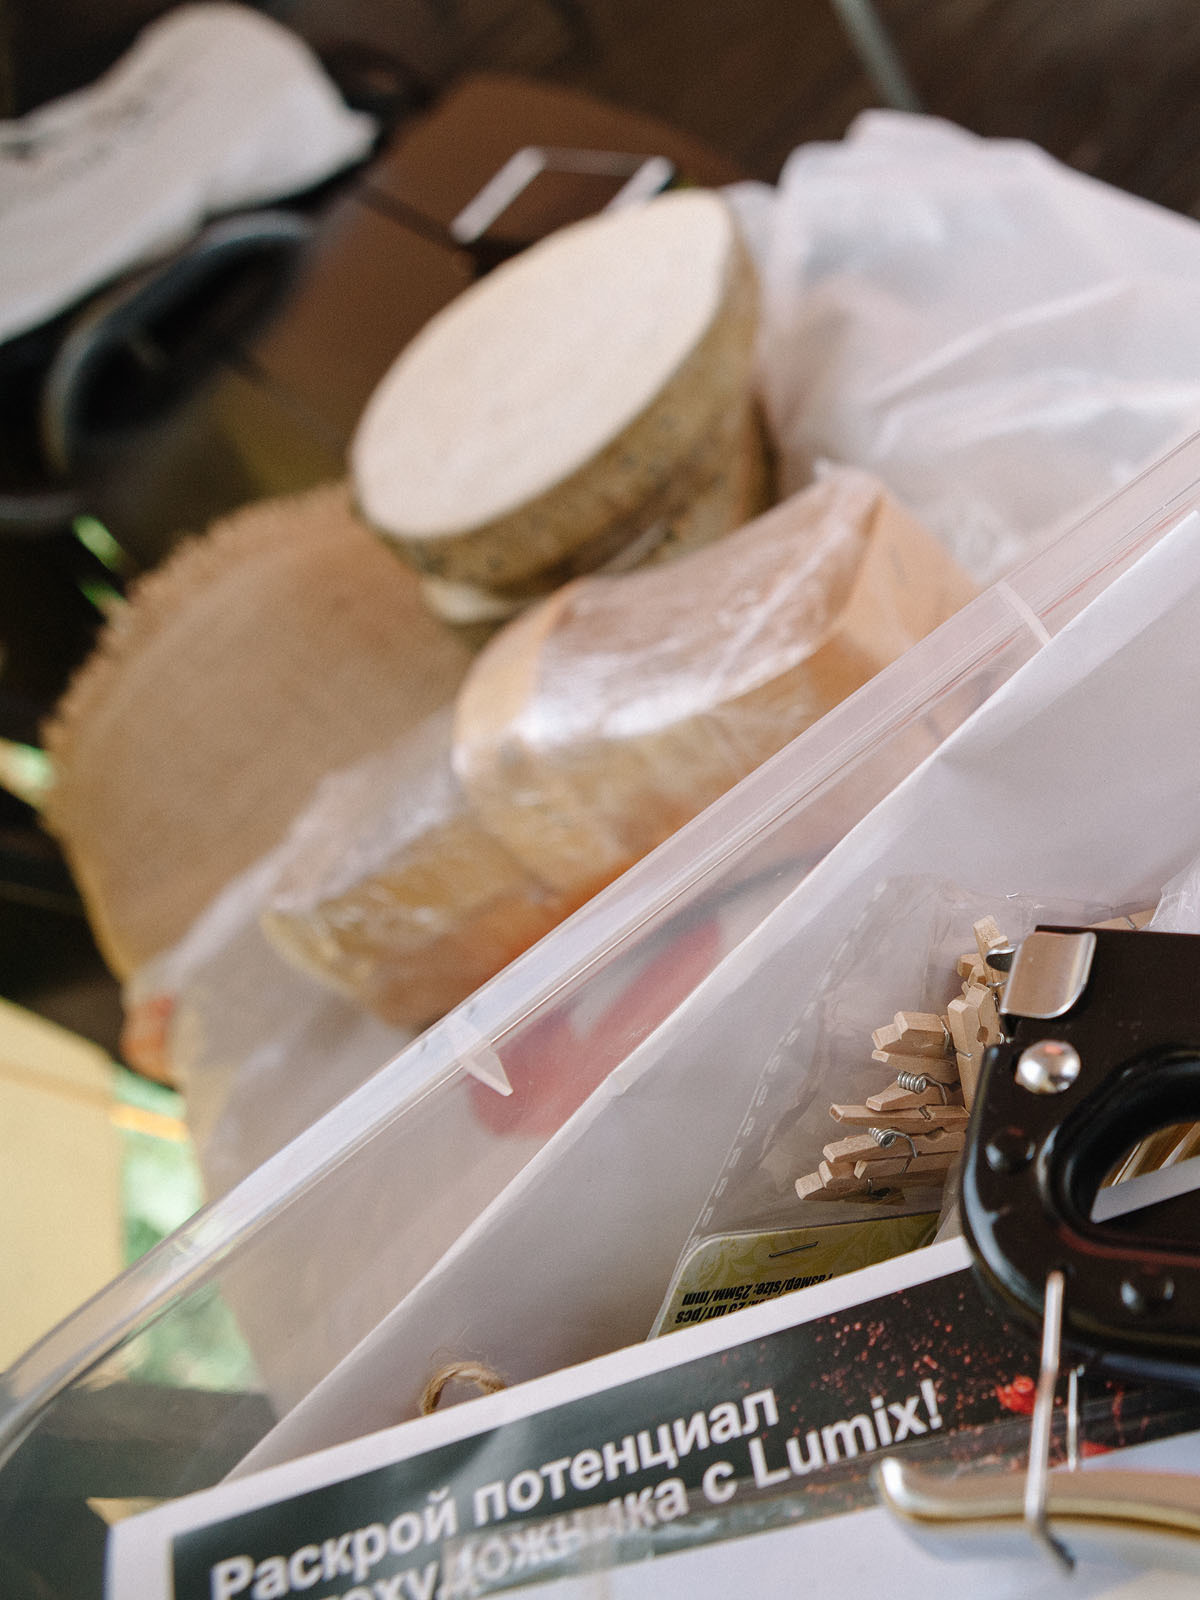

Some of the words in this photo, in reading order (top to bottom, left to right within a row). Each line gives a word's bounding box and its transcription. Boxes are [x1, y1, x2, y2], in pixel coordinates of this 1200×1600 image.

[209, 1486, 458, 1600] Раскрой
[472, 1388, 780, 1526] потенциал
[701, 1461, 737, 1504] с
[748, 1378, 945, 1489] Lumix!
